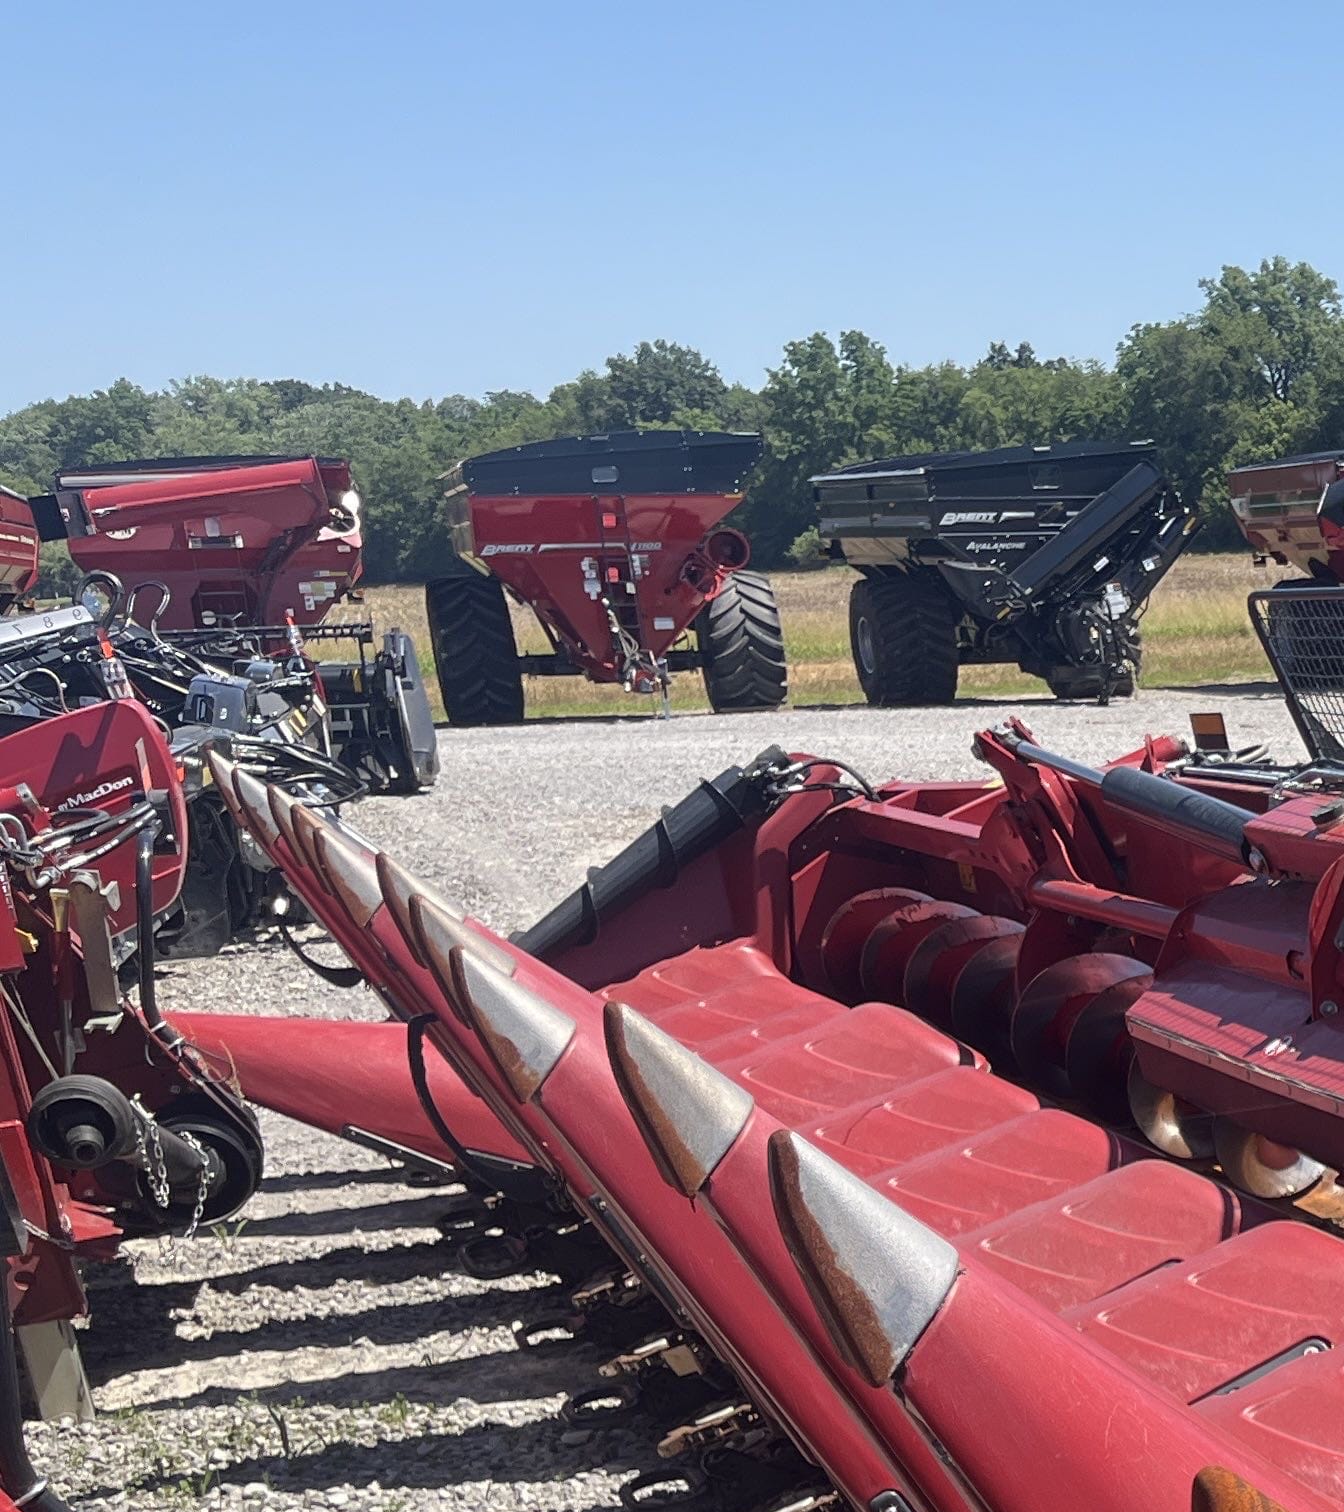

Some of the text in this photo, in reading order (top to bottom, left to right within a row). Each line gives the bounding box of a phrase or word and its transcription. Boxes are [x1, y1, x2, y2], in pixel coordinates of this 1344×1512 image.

[939, 511, 997, 525] BRENT
[480, 543, 534, 556] BRENT
[966, 541, 1026, 551] AVALANCHE
[67, 776, 133, 807] MacDon
